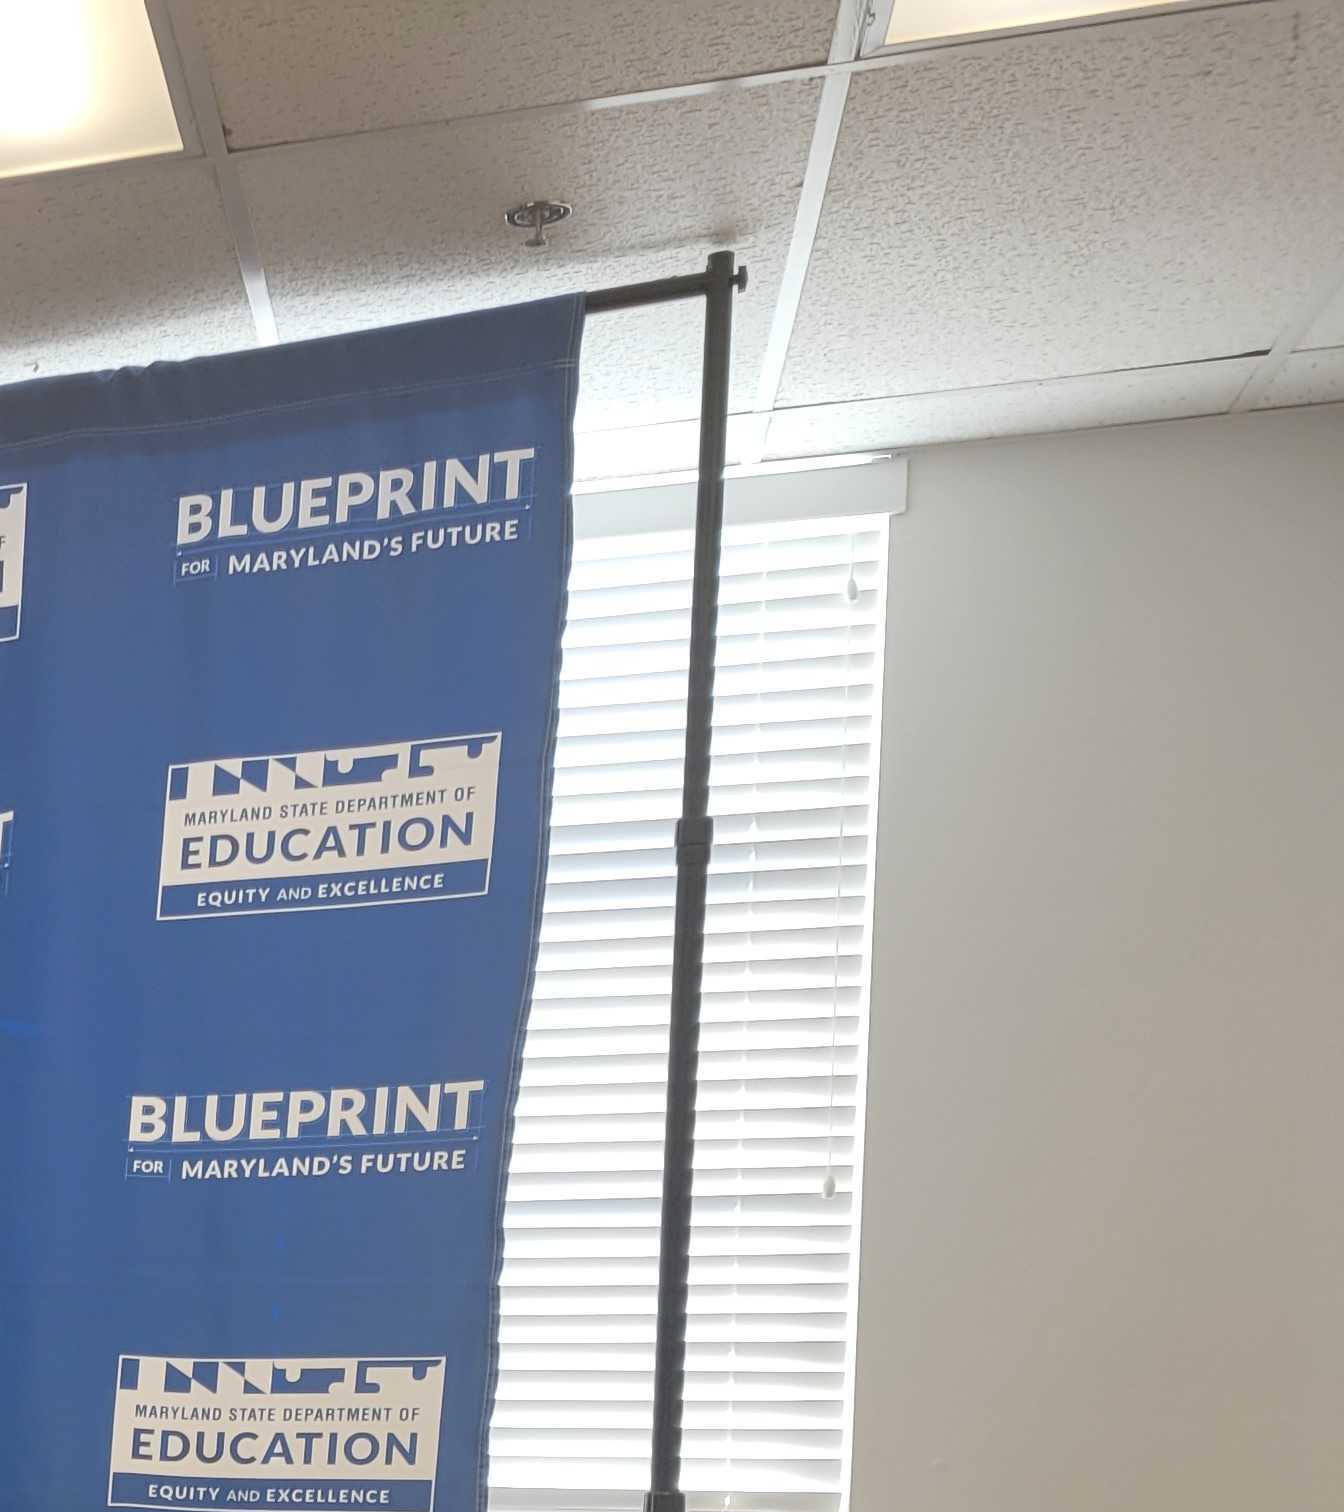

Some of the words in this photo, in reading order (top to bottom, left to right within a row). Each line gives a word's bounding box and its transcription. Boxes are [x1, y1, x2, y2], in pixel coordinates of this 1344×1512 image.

[177, 448, 534, 545] BLUEPRINT
[182, 559, 209, 576] FOR
[229, 536, 402, 574] MARYLAND'S
[412, 520, 518, 552] FUTURE
[184, 806, 272, 826] MARYLAND
[280, 802, 328, 818] STATE
[336, 789, 446, 814] DEPARTMENT
[455, 786, 475, 801] OF
[181, 811, 474, 870] EDUCATION
[198, 888, 270, 907] EQUITY
[277, 888, 311, 900] AND
[318, 874, 444, 898] EXCELLENCE
[129, 1080, 484, 1142] BLUEPRINT
[133, 1160, 163, 1173] FOR
[182, 1155, 352, 1179] MARYLAND'S
[361, 1150, 466, 1173] FUTURE
[136, 1404, 221, 1420] MARYLAND
[229, 1408, 275, 1421] STATE
[283, 1408, 392, 1421] DEPARTMENT
[400, 1408, 420, 1421] OF
[132, 1428, 418, 1465] EDUCATION
[149, 1484, 219, 1500] EQUITY
[227, 1490, 260, 1502] AND
[267, 1489, 389, 1503] EXCELLENCE
